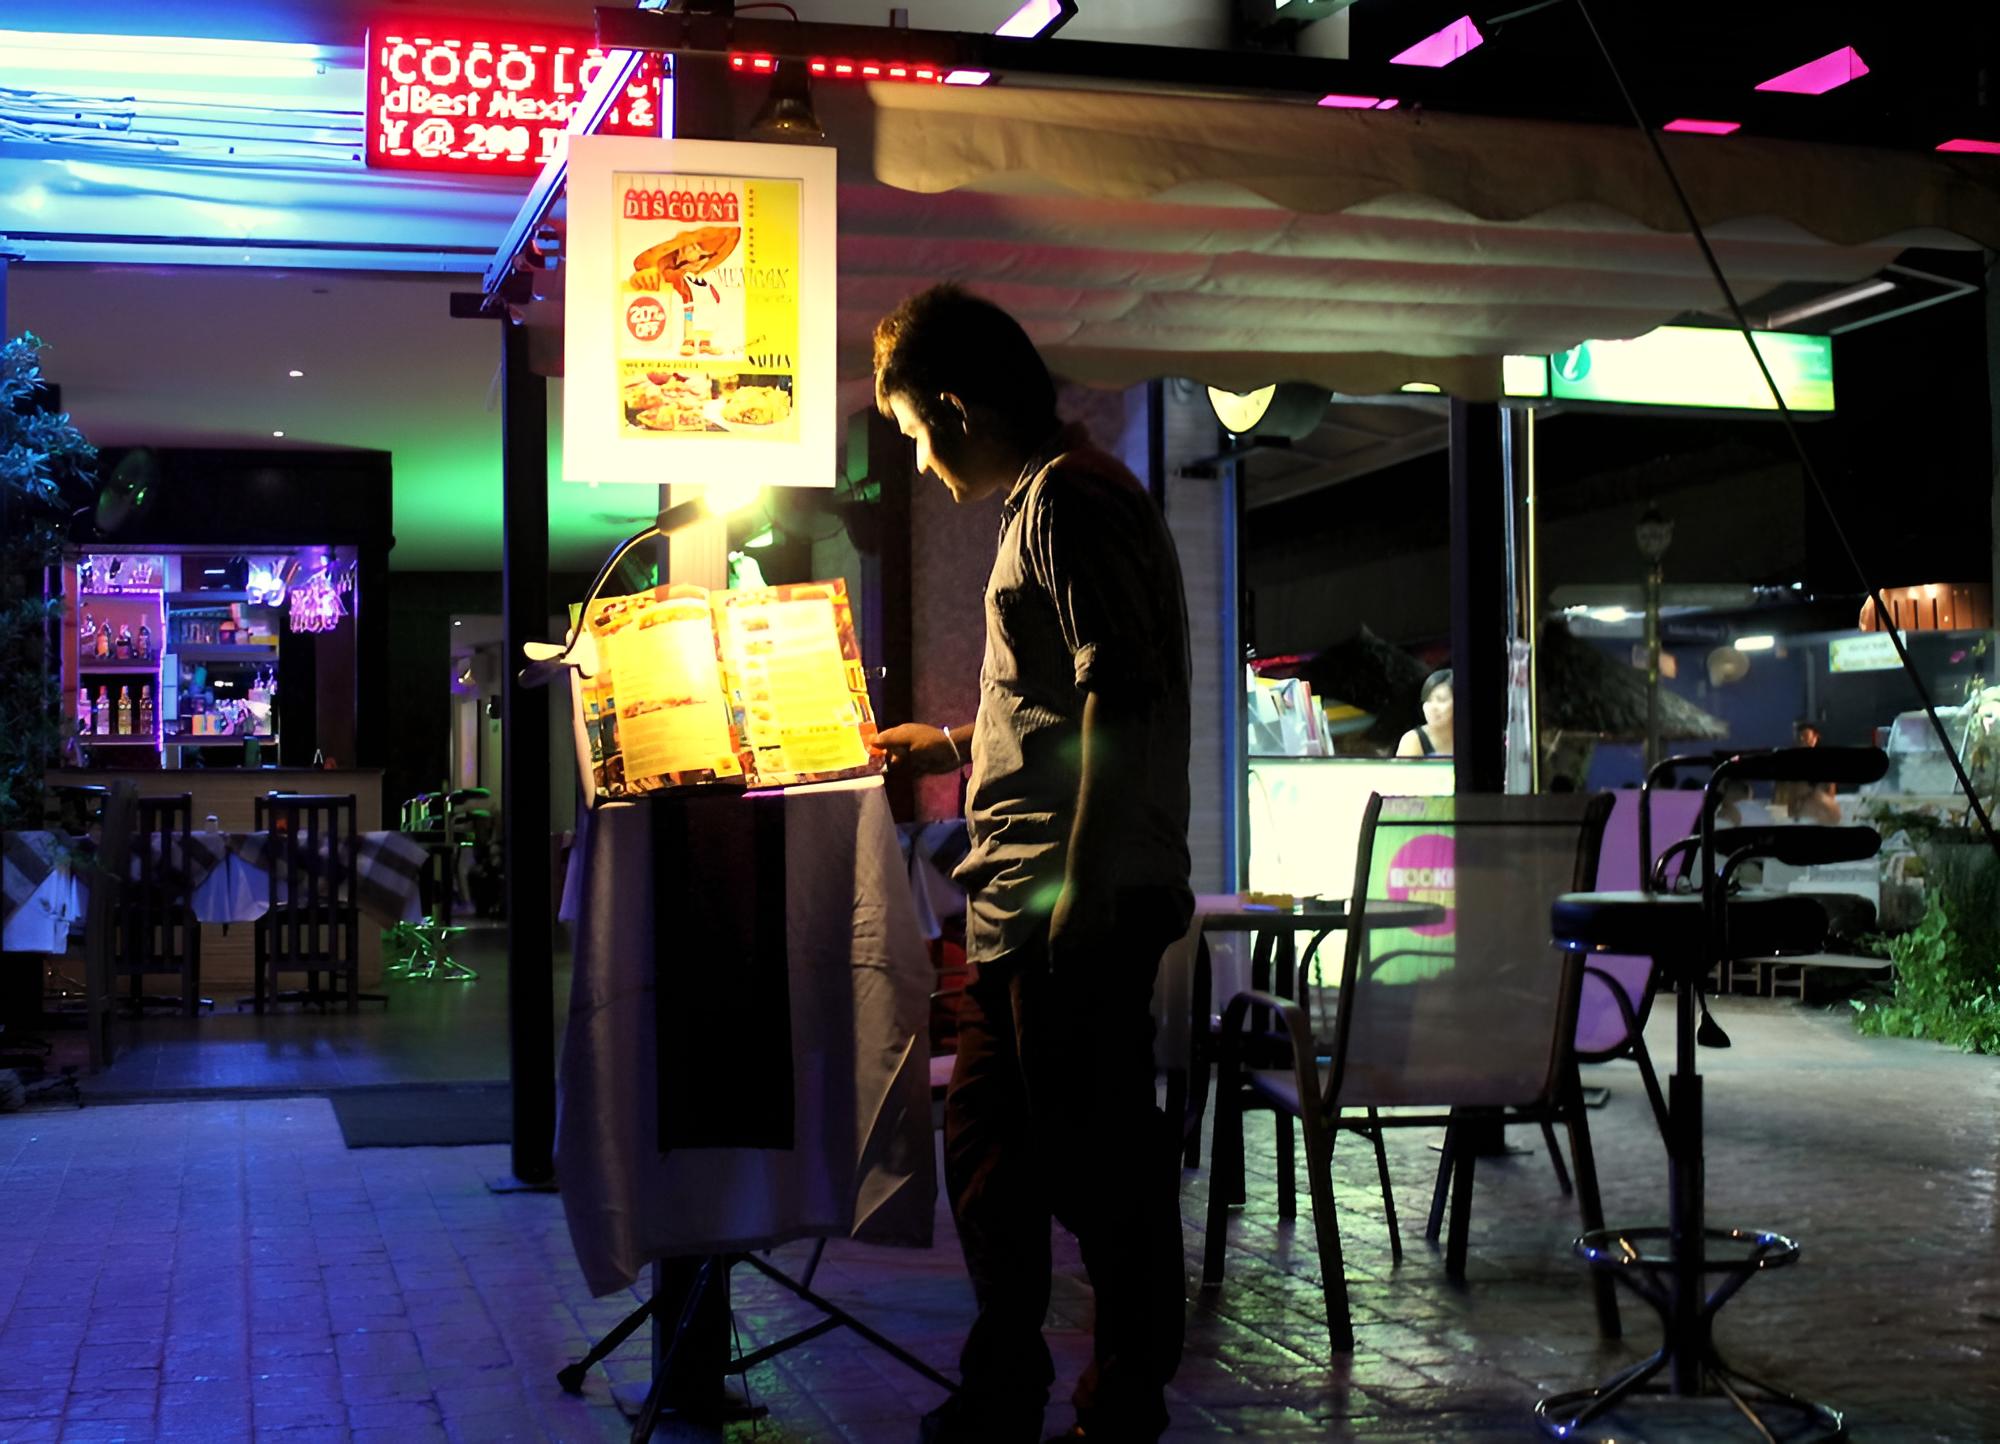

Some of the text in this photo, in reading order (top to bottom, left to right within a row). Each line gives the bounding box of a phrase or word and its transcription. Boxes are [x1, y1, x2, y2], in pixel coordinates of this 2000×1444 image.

[389, 44, 535, 91] COCO
[413, 118, 455, 157] @
[625, 199, 739, 219] DISCOUNT
[635, 322, 660, 338] OFF
